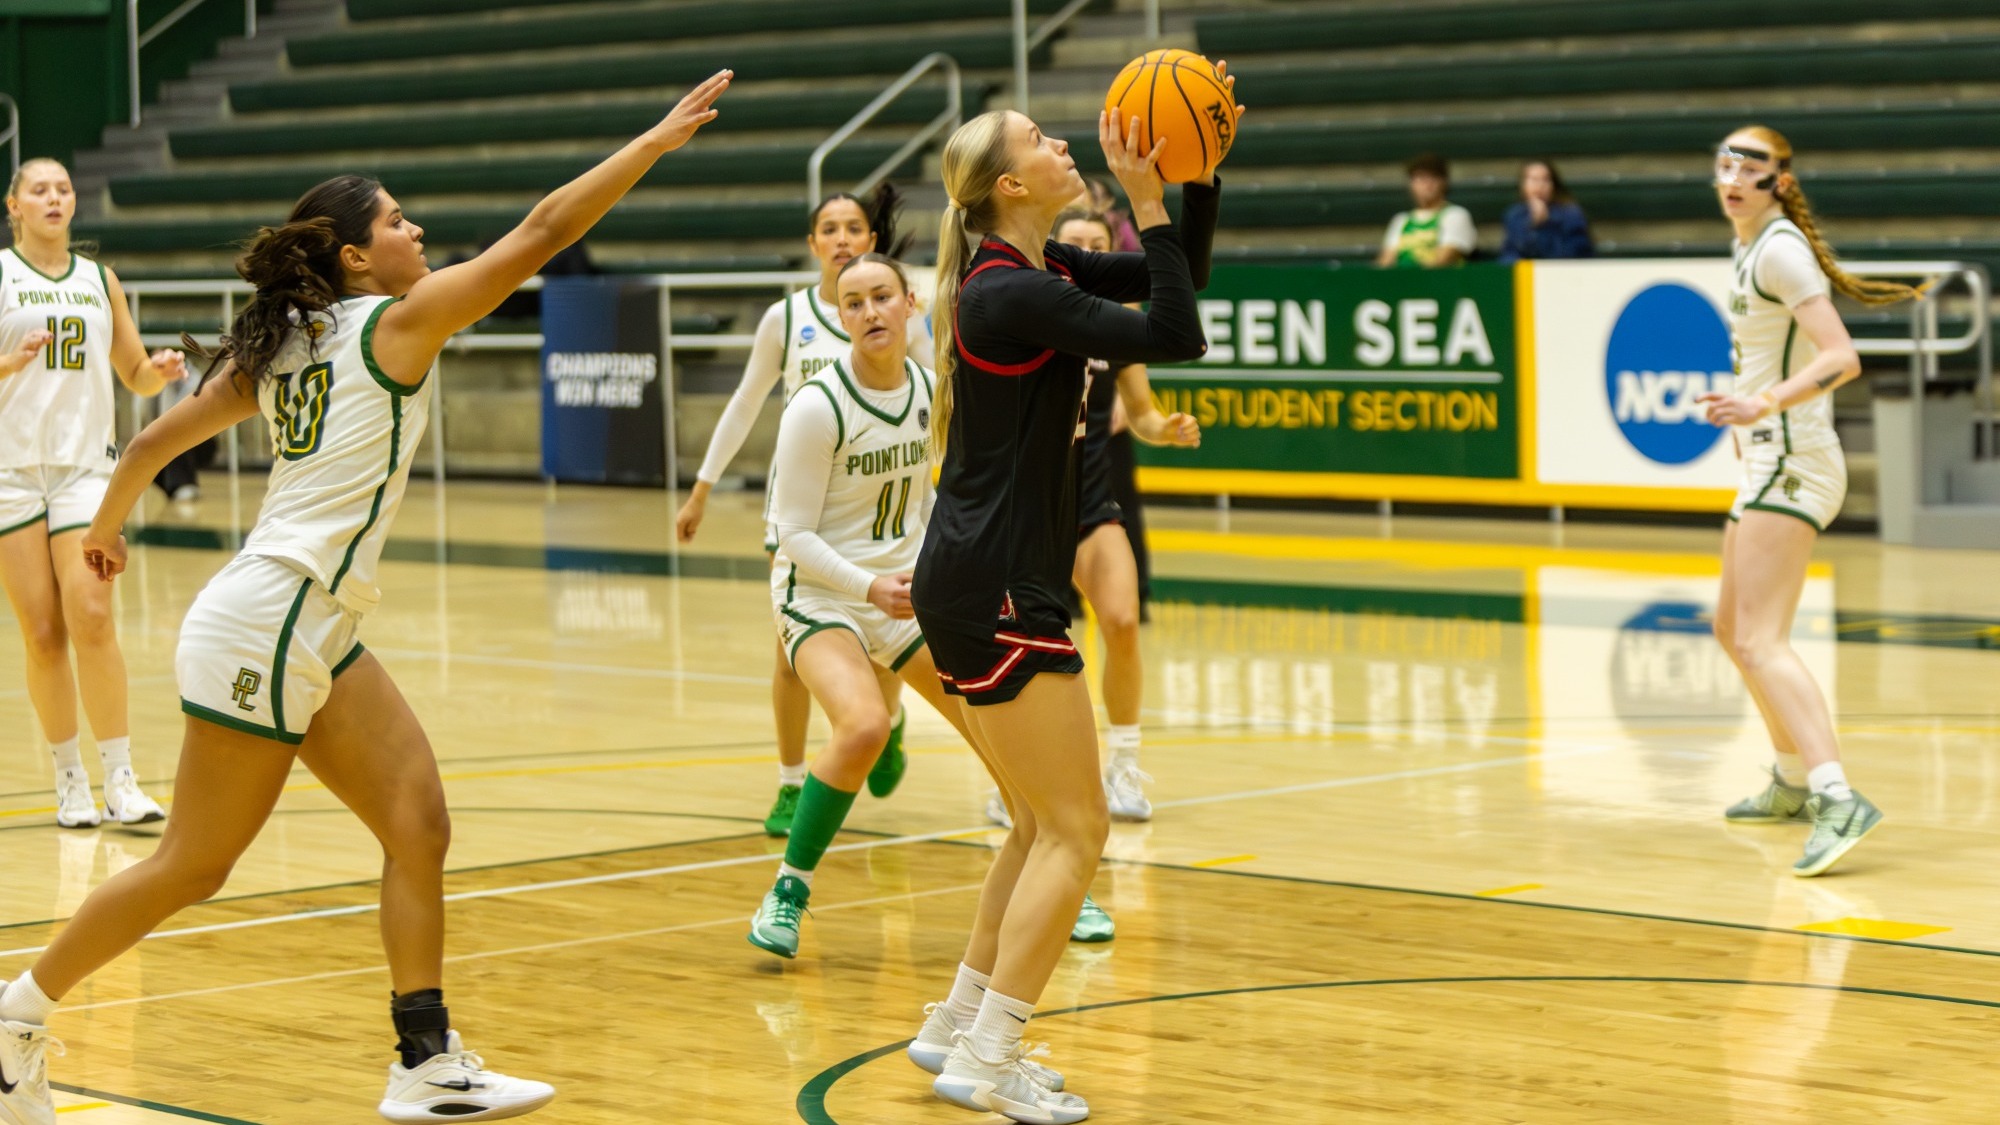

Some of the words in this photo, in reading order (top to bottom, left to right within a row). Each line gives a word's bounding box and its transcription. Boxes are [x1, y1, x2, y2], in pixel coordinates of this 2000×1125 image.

[18, 289, 61, 307] POINT
[46, 315, 86, 370] 12
[1195, 299, 1327, 365] EEN
[1353, 297, 1495, 367] SEA
[1197, 387, 1345, 429] STUDENT
[1348, 390, 1498, 431] SECTION
[846, 444, 900, 475] POINT
[872, 476, 912, 541] 11
